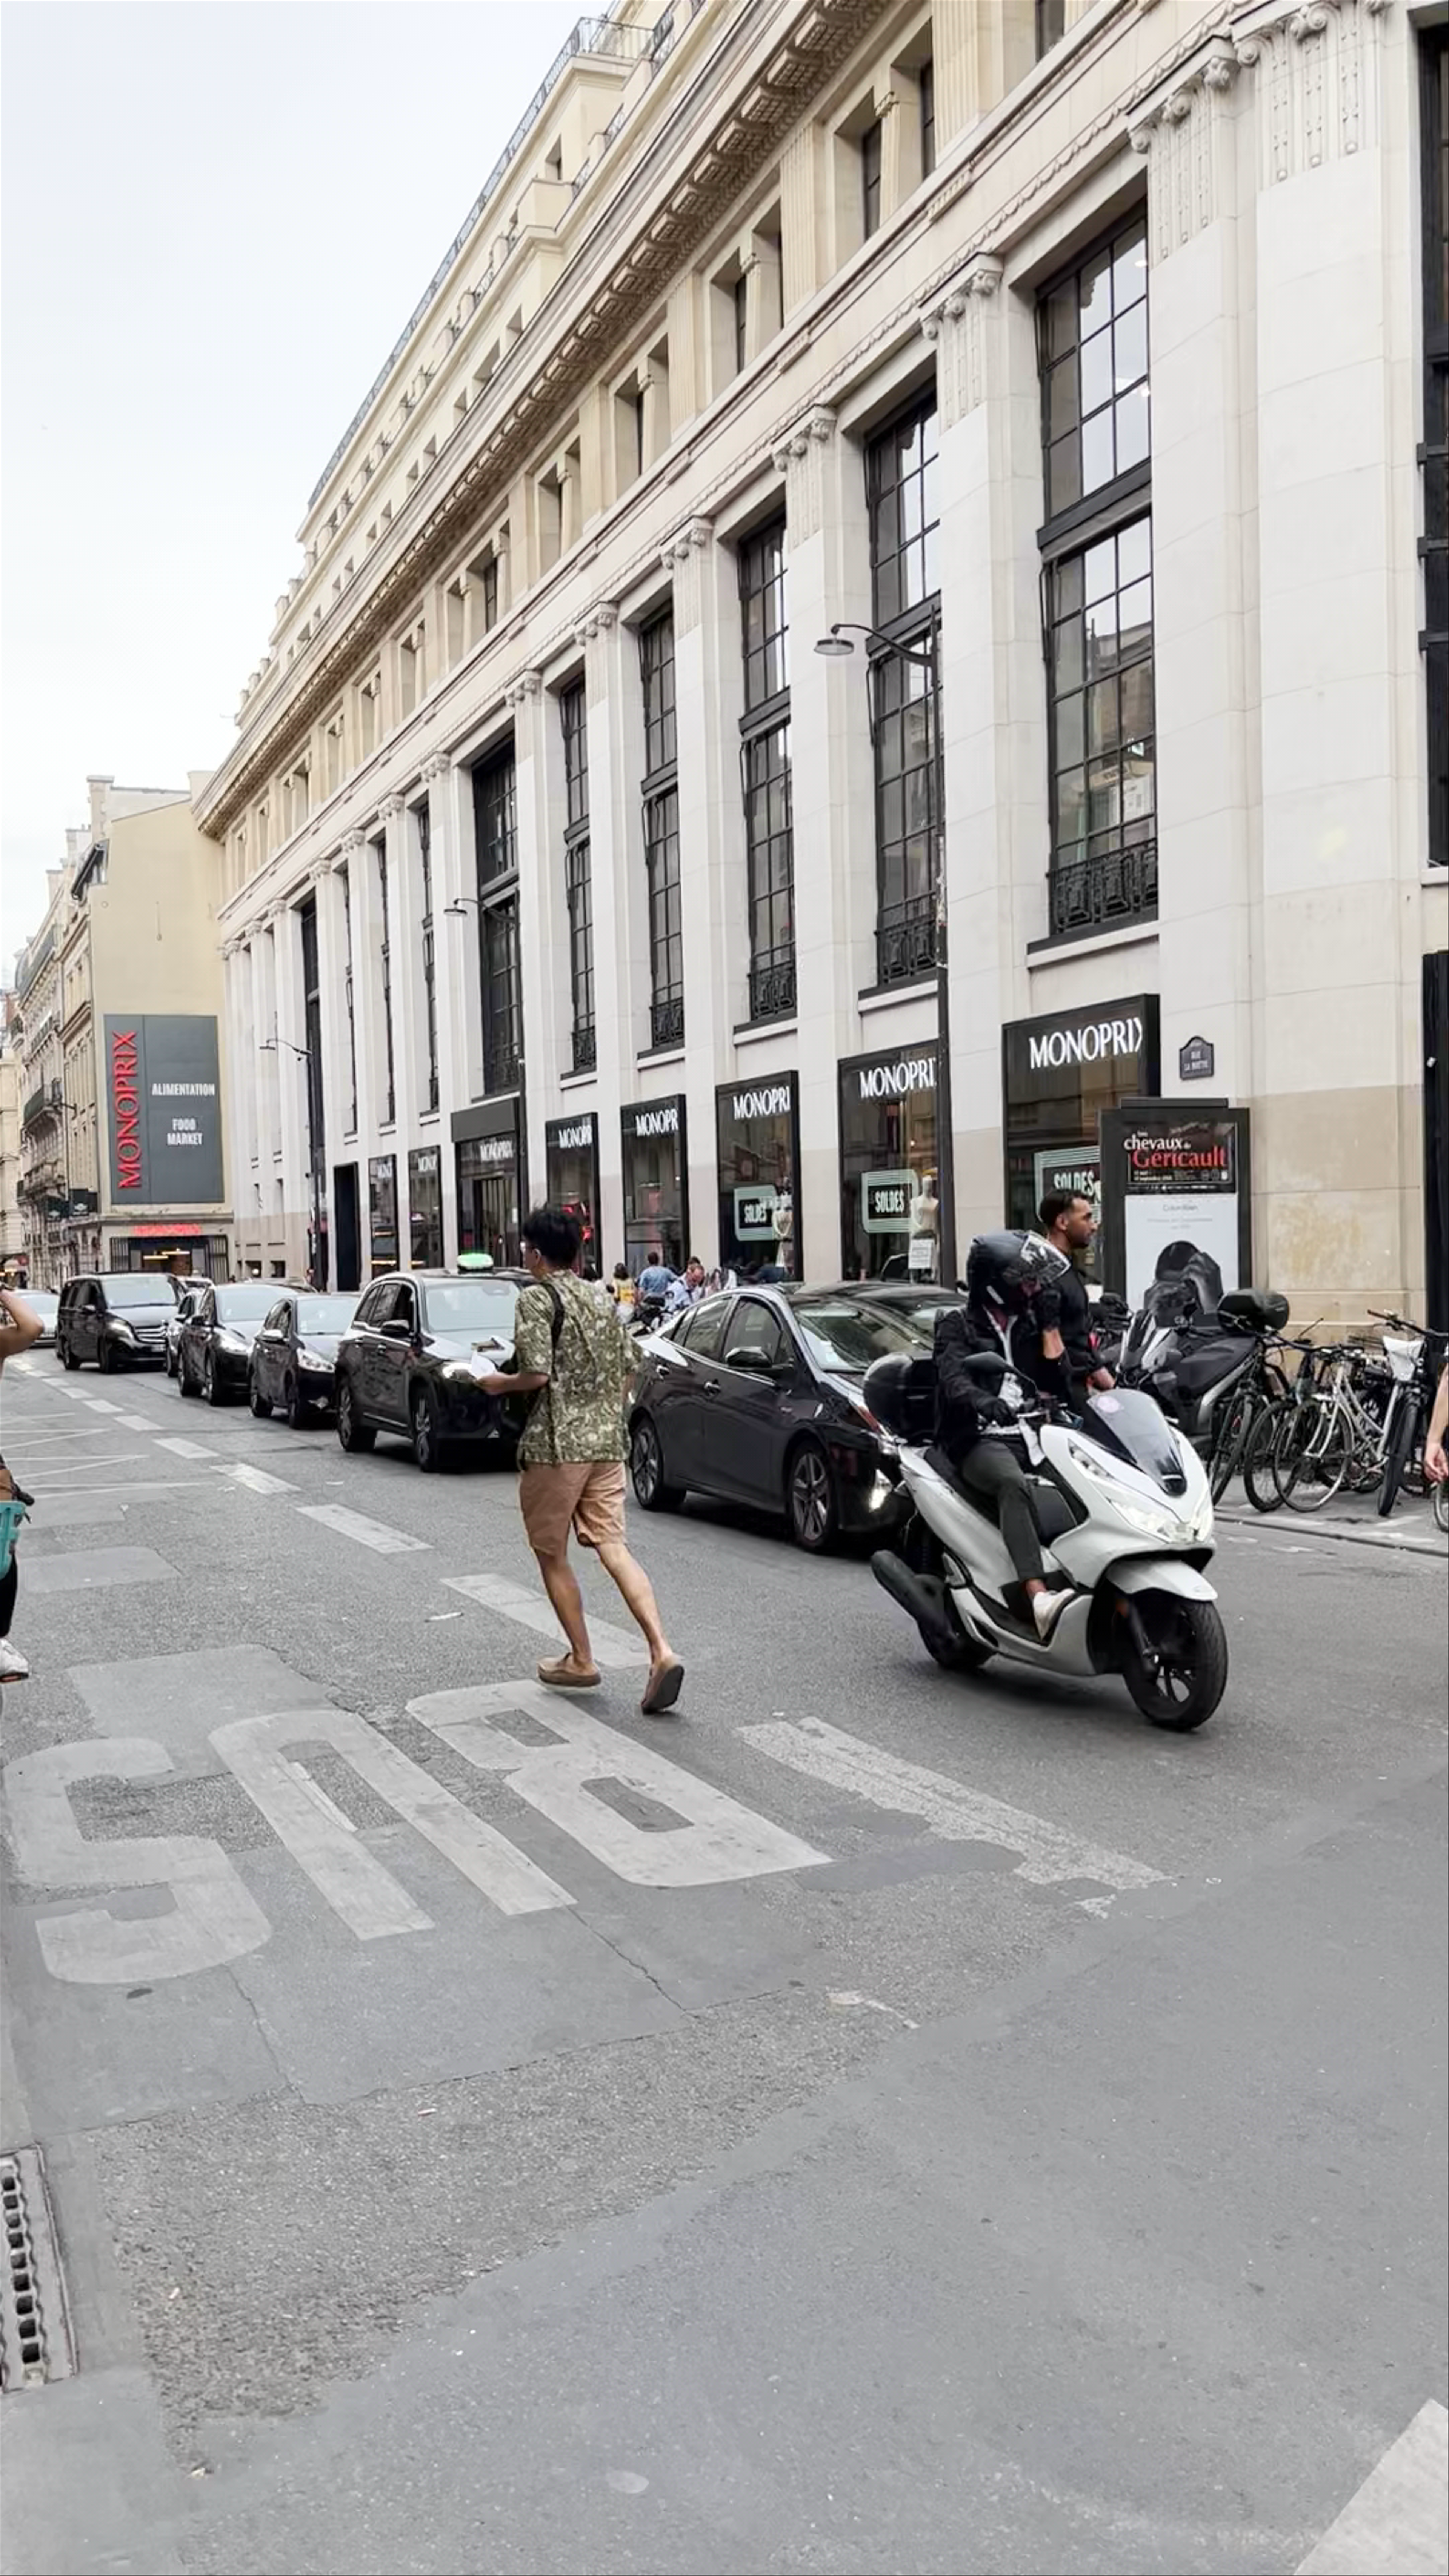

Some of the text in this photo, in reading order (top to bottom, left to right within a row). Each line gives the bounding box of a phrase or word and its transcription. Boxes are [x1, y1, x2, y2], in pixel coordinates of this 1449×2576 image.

[860, 1057, 937, 1099] MONOPRI
[152, 1083, 215, 1096] ALIMENTATION
[113, 1030, 142, 1189] MONOPRIX
[172, 1118, 196, 1131] FOOD
[167, 1133, 203, 1146] MARKET
[1123, 1133, 1182, 1150] chevaux
[875, 1189, 904, 1213] SOLDES
